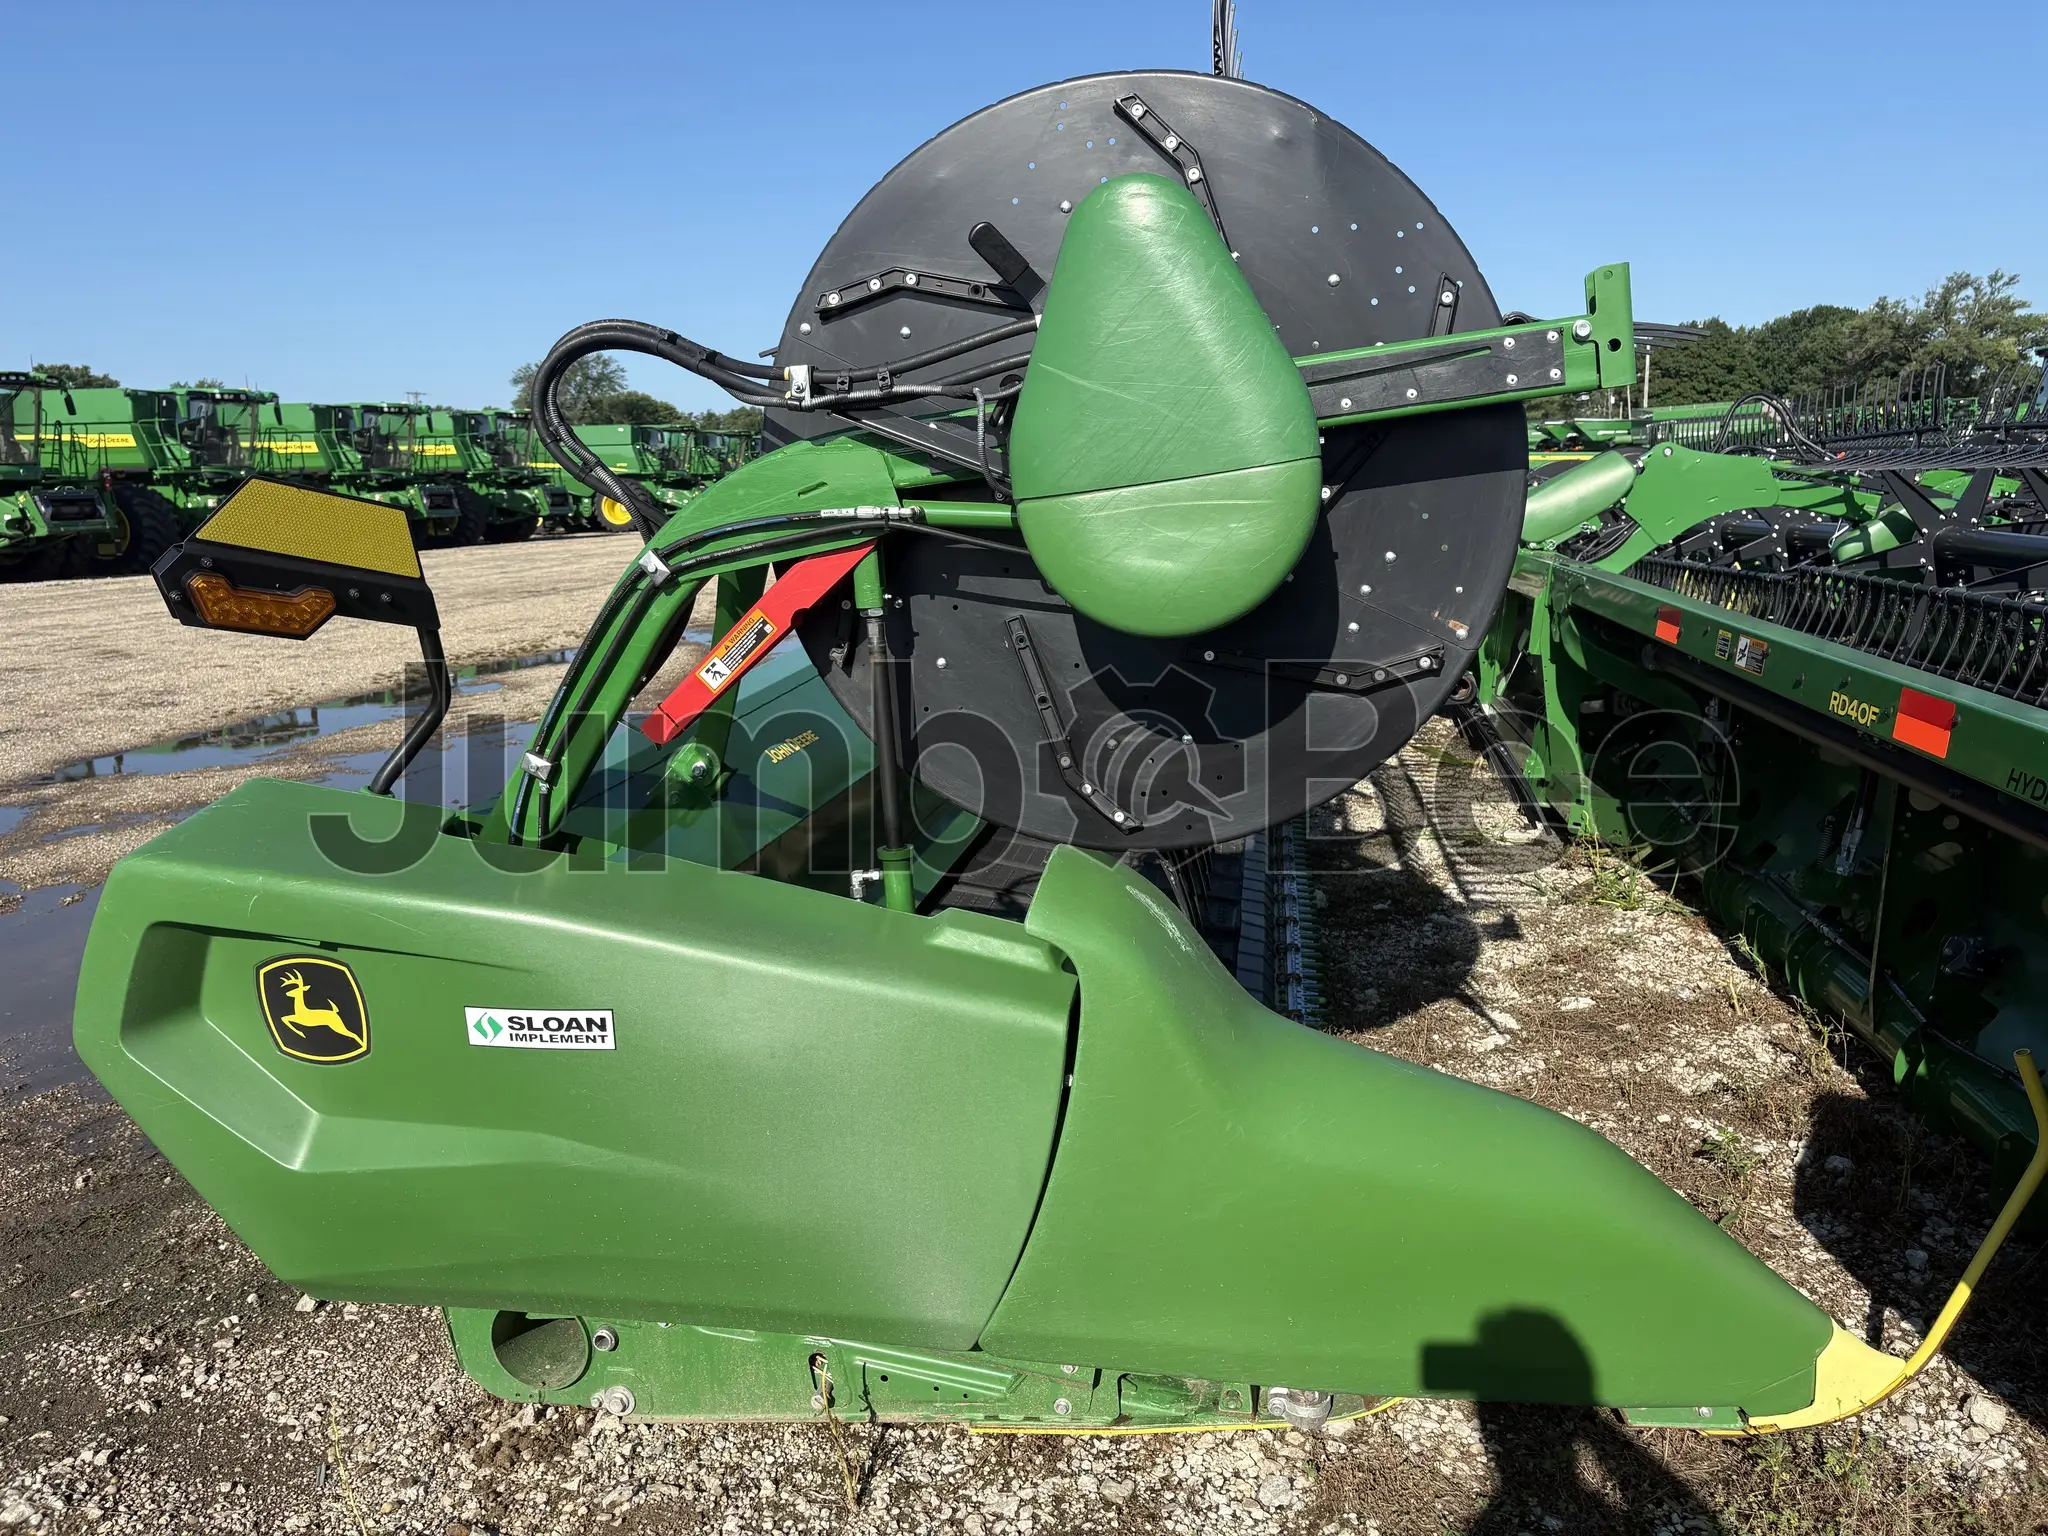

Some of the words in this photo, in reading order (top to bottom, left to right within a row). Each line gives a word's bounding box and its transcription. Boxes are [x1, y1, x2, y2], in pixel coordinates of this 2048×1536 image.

[729, 617, 755, 643] WARNING
[1828, 690, 1880, 727] RD40F
[764, 742, 795, 764] JOHN
[784, 729, 820, 752] DEERE
[2005, 767, 2048, 806] HYD
[507, 1016, 607, 1032] SLOAN
[509, 1033, 608, 1044] IMPLEMENT
